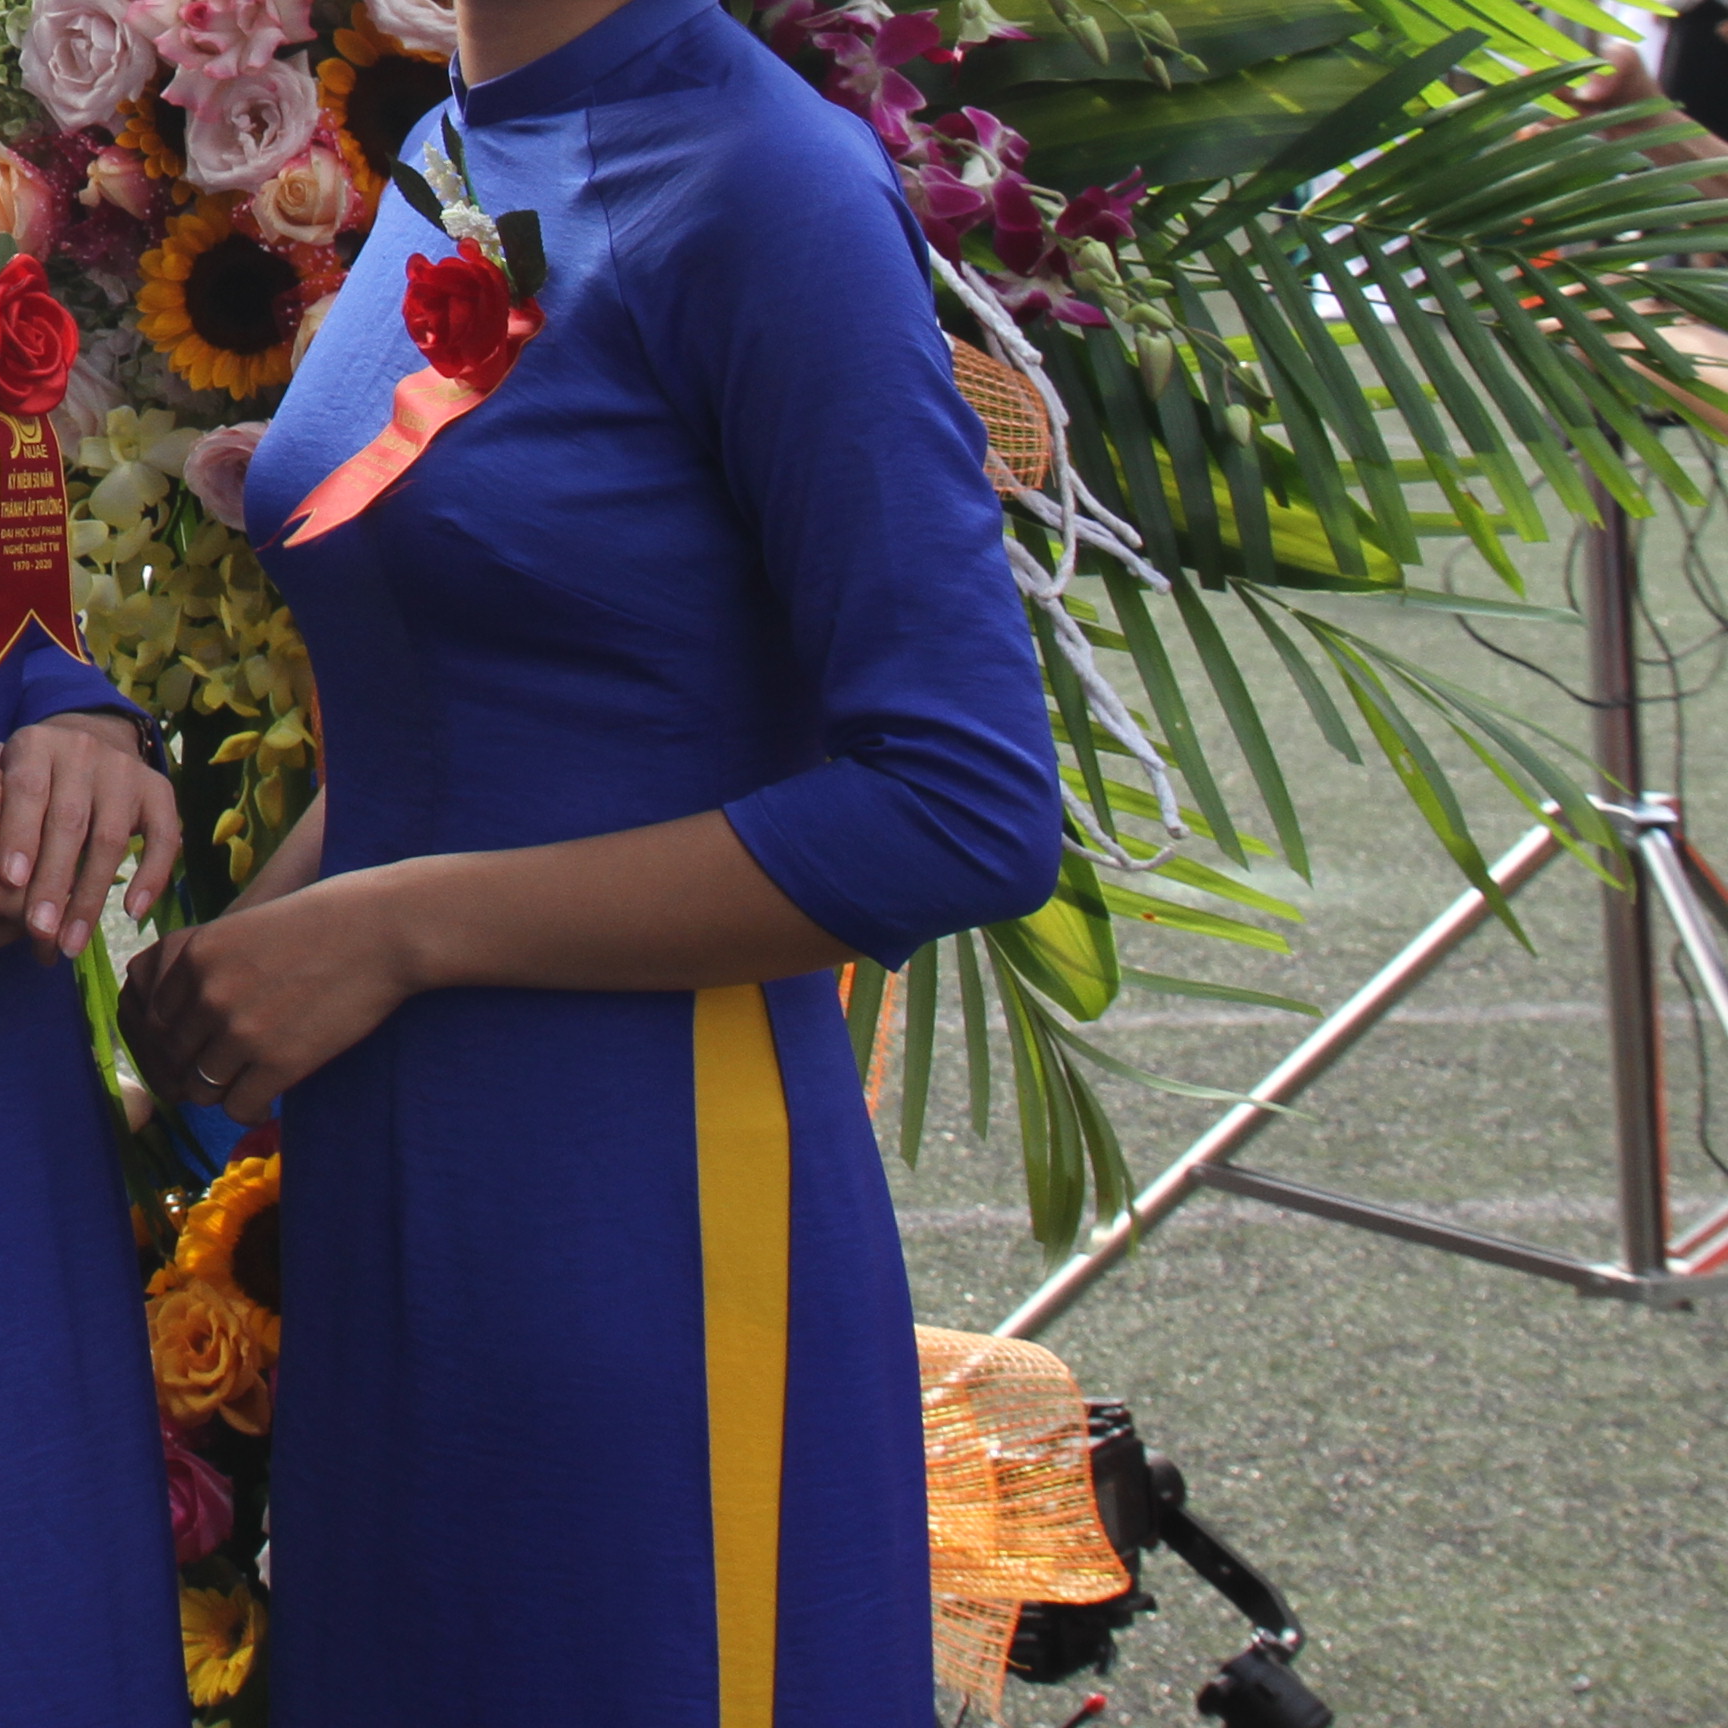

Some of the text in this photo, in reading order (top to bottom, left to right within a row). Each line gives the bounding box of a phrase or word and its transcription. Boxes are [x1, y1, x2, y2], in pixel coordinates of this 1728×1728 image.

[23, 444, 49, 459] NUAE
[13, 560, 30, 571] 1970
[35, 559, 53, 570] 2020
